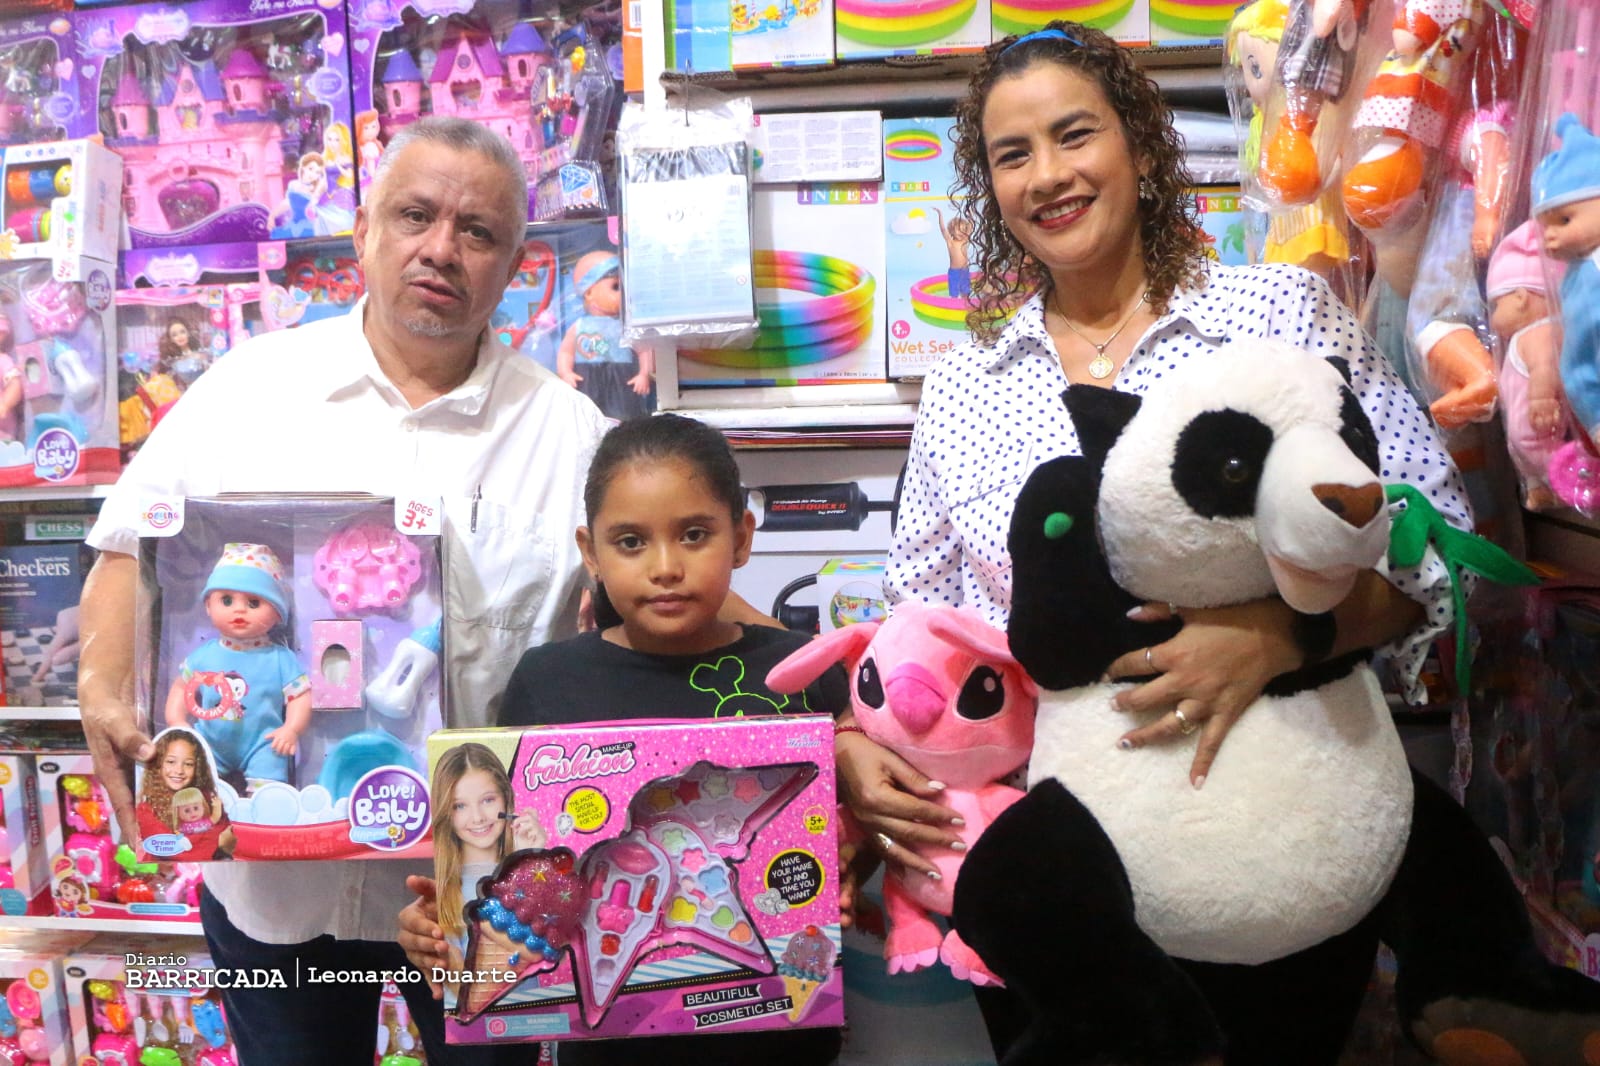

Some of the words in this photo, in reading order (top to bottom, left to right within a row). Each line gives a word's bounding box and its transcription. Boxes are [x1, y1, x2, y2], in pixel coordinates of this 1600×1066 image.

[802, 189, 873, 201] INTEX
[890, 340, 924, 354] Wet
[928, 340, 954, 354] Set
[37, 449, 75, 469] Baby
[408, 500, 434, 517] AGES
[402, 508, 426, 529] 3+
[38, 523, 81, 532] CHESS
[355, 798, 427, 831] Baby
[810, 816, 823, 825] 5+
[780, 855, 801, 867] HAVE
[792, 861, 813, 873] MAKE
[782, 877, 792, 885] UP
[793, 871, 809, 882] AND
[781, 883, 799, 894] TIME
[800, 879, 815, 889] YOU
[787, 889, 811, 901] WANT
[686, 986, 753, 1005] BEAUTIFUL
[700, 1004, 764, 1024] COSMETIC
[766, 998, 789, 1012] SET
